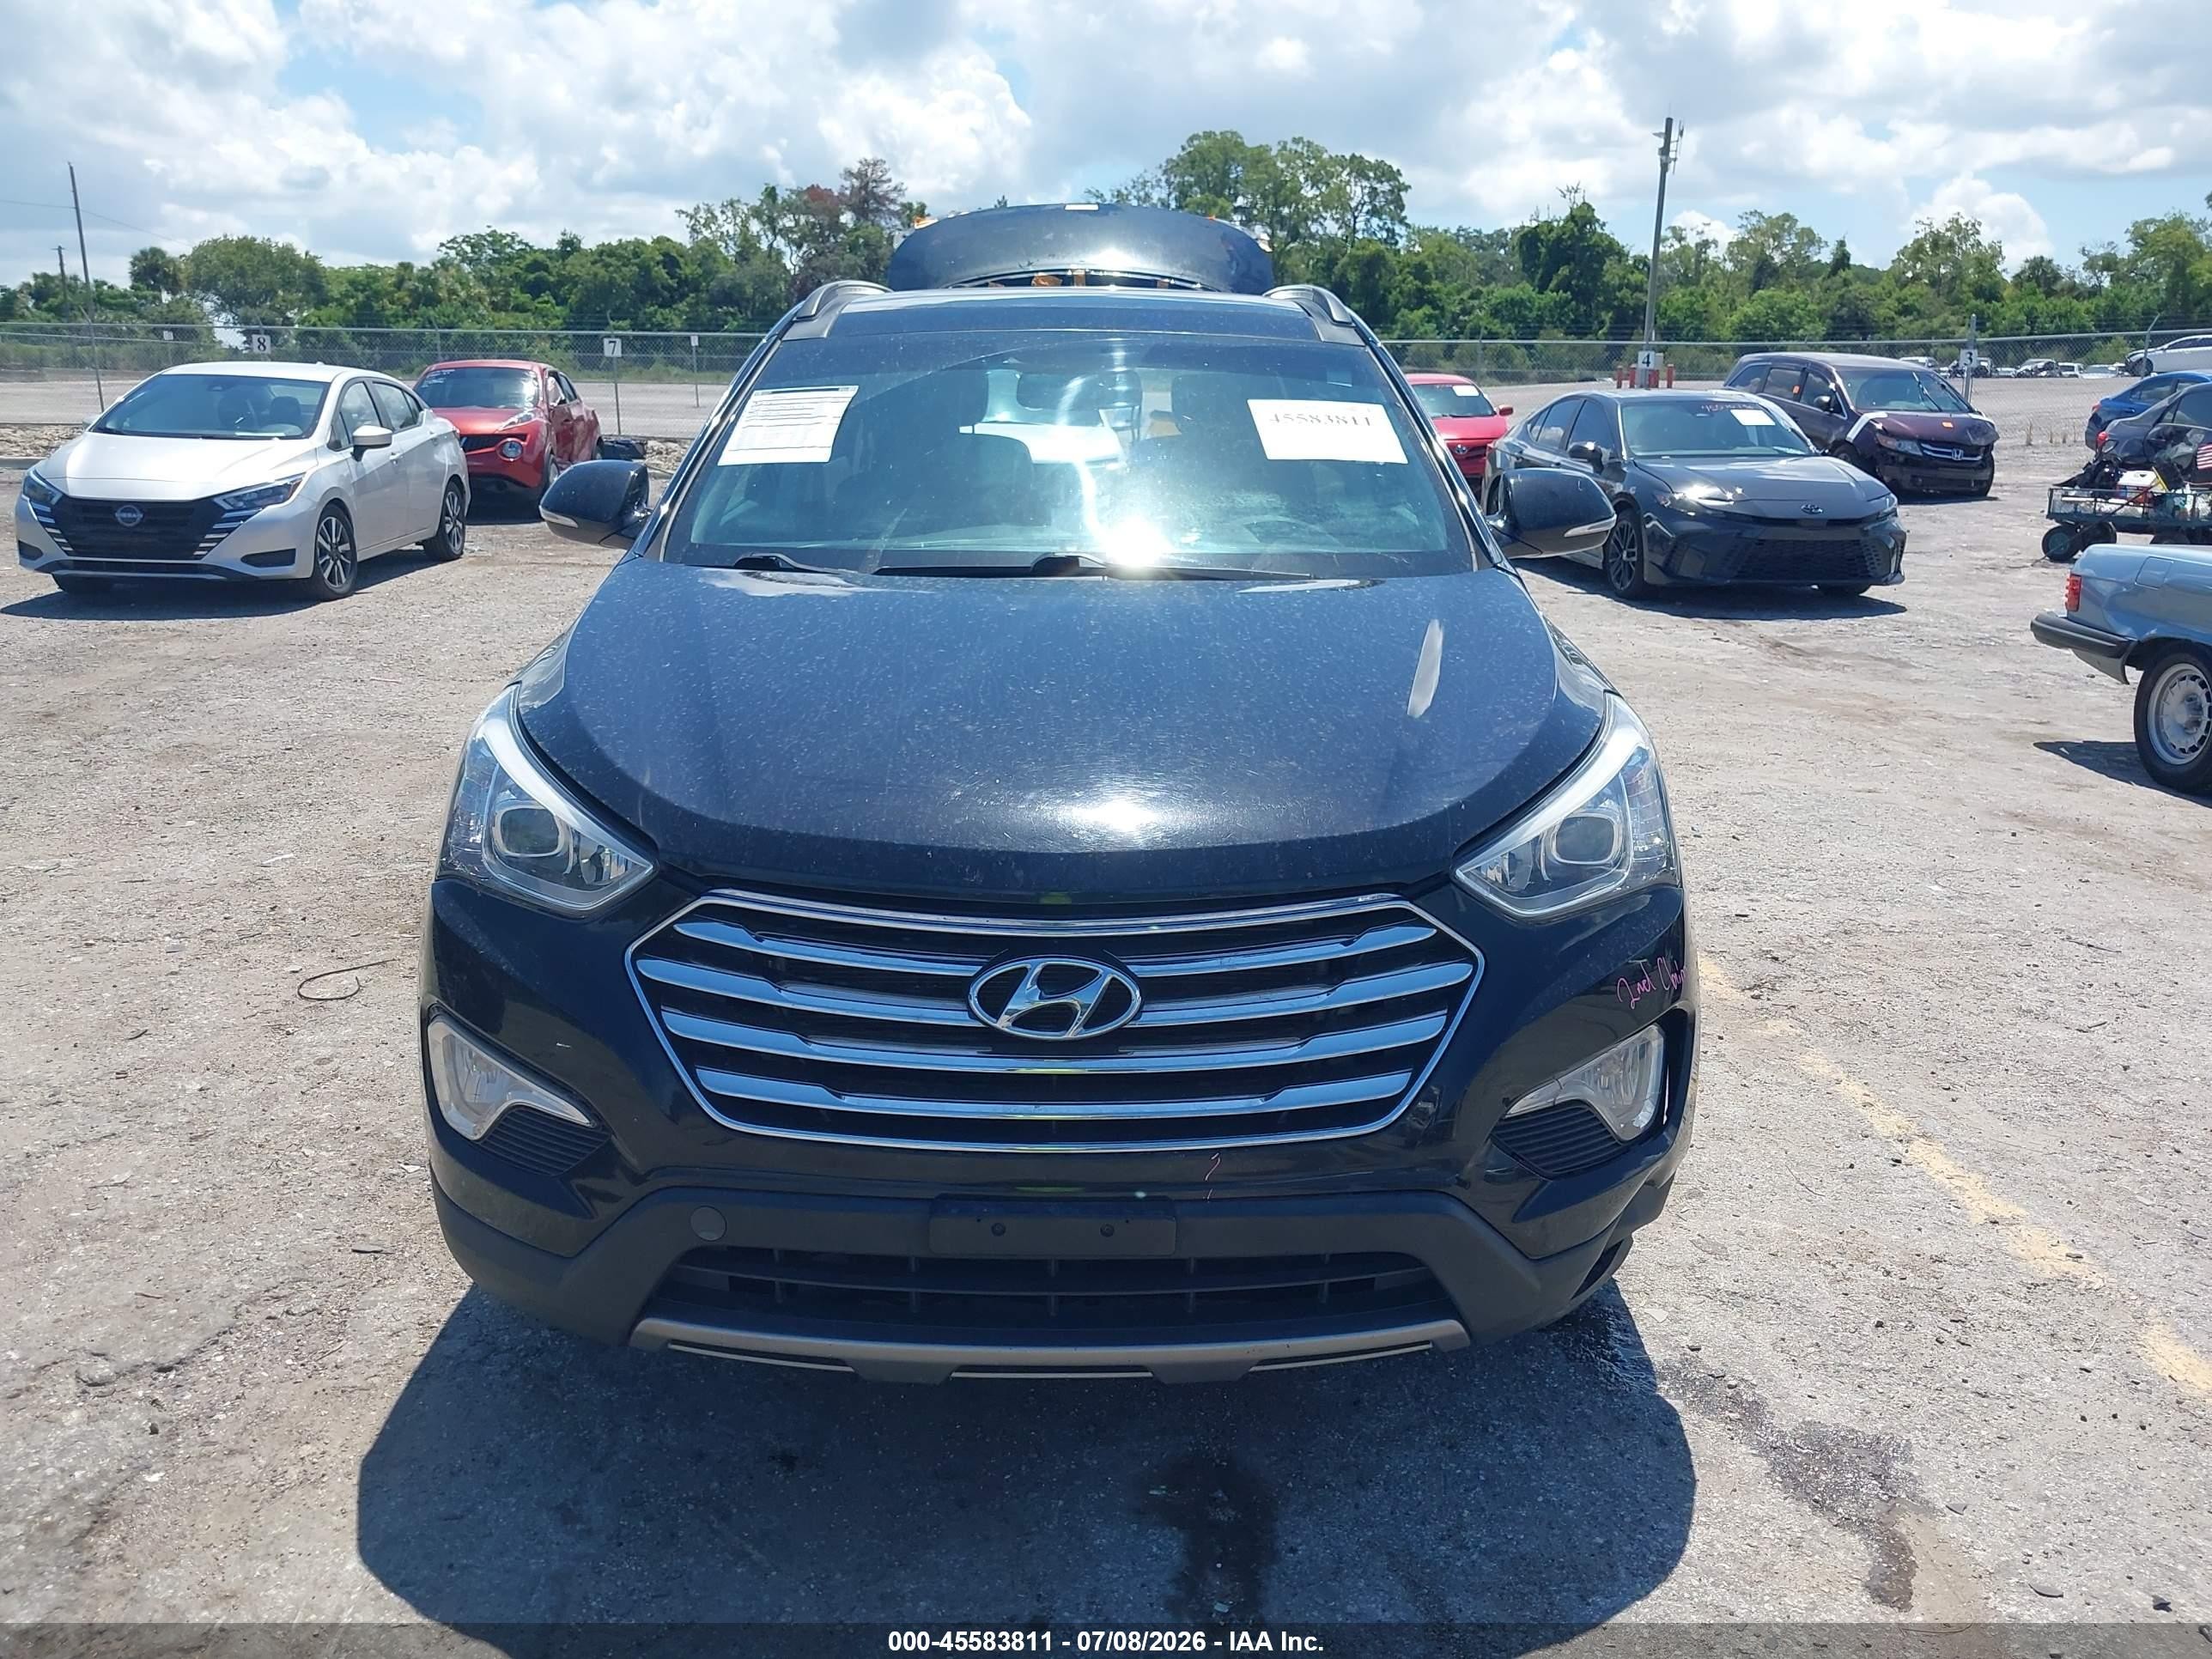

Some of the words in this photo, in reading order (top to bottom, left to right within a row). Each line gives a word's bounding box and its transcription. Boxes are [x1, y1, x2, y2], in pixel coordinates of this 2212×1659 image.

[258, 337, 266, 352] 8
[608, 340, 617, 356] 7
[1641, 353, 1650, 368] 4
[1963, 351, 1973, 366] 3
